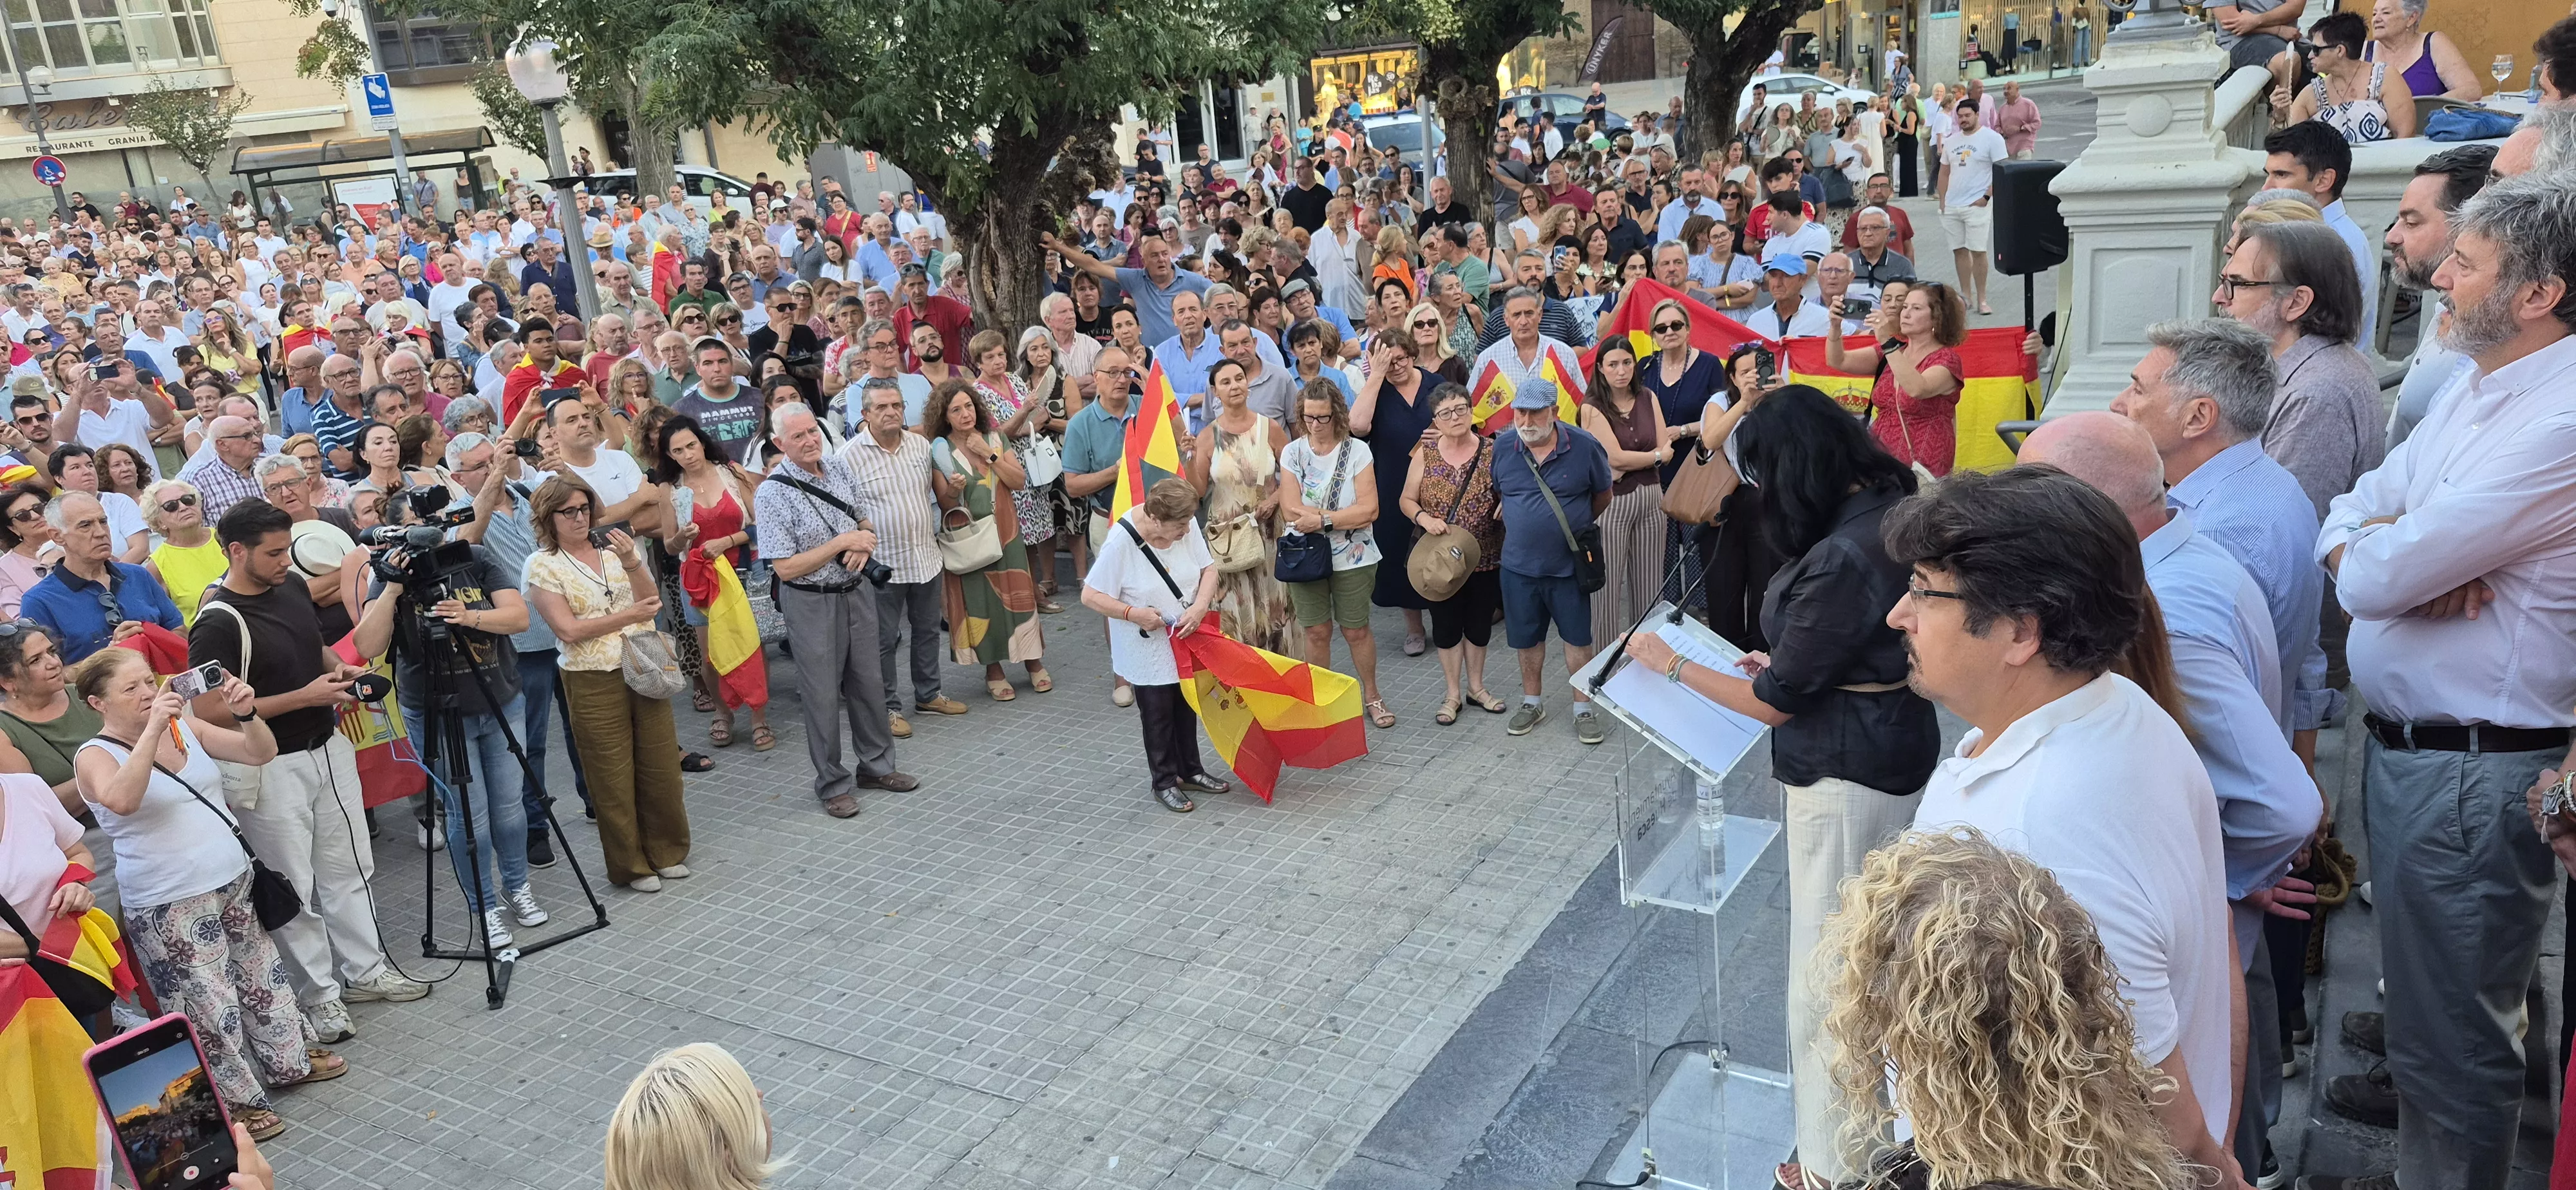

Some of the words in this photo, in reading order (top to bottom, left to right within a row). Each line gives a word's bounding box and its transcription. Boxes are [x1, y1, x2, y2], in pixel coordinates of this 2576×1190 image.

[1587, 32, 1613, 73] UNYKER
[25, 140, 95, 153] REAURANTE
[108, 135, 147, 146] GRANJA
[701, 406, 753, 419] MAMMUT
[702, 415, 732, 424] SINCE
